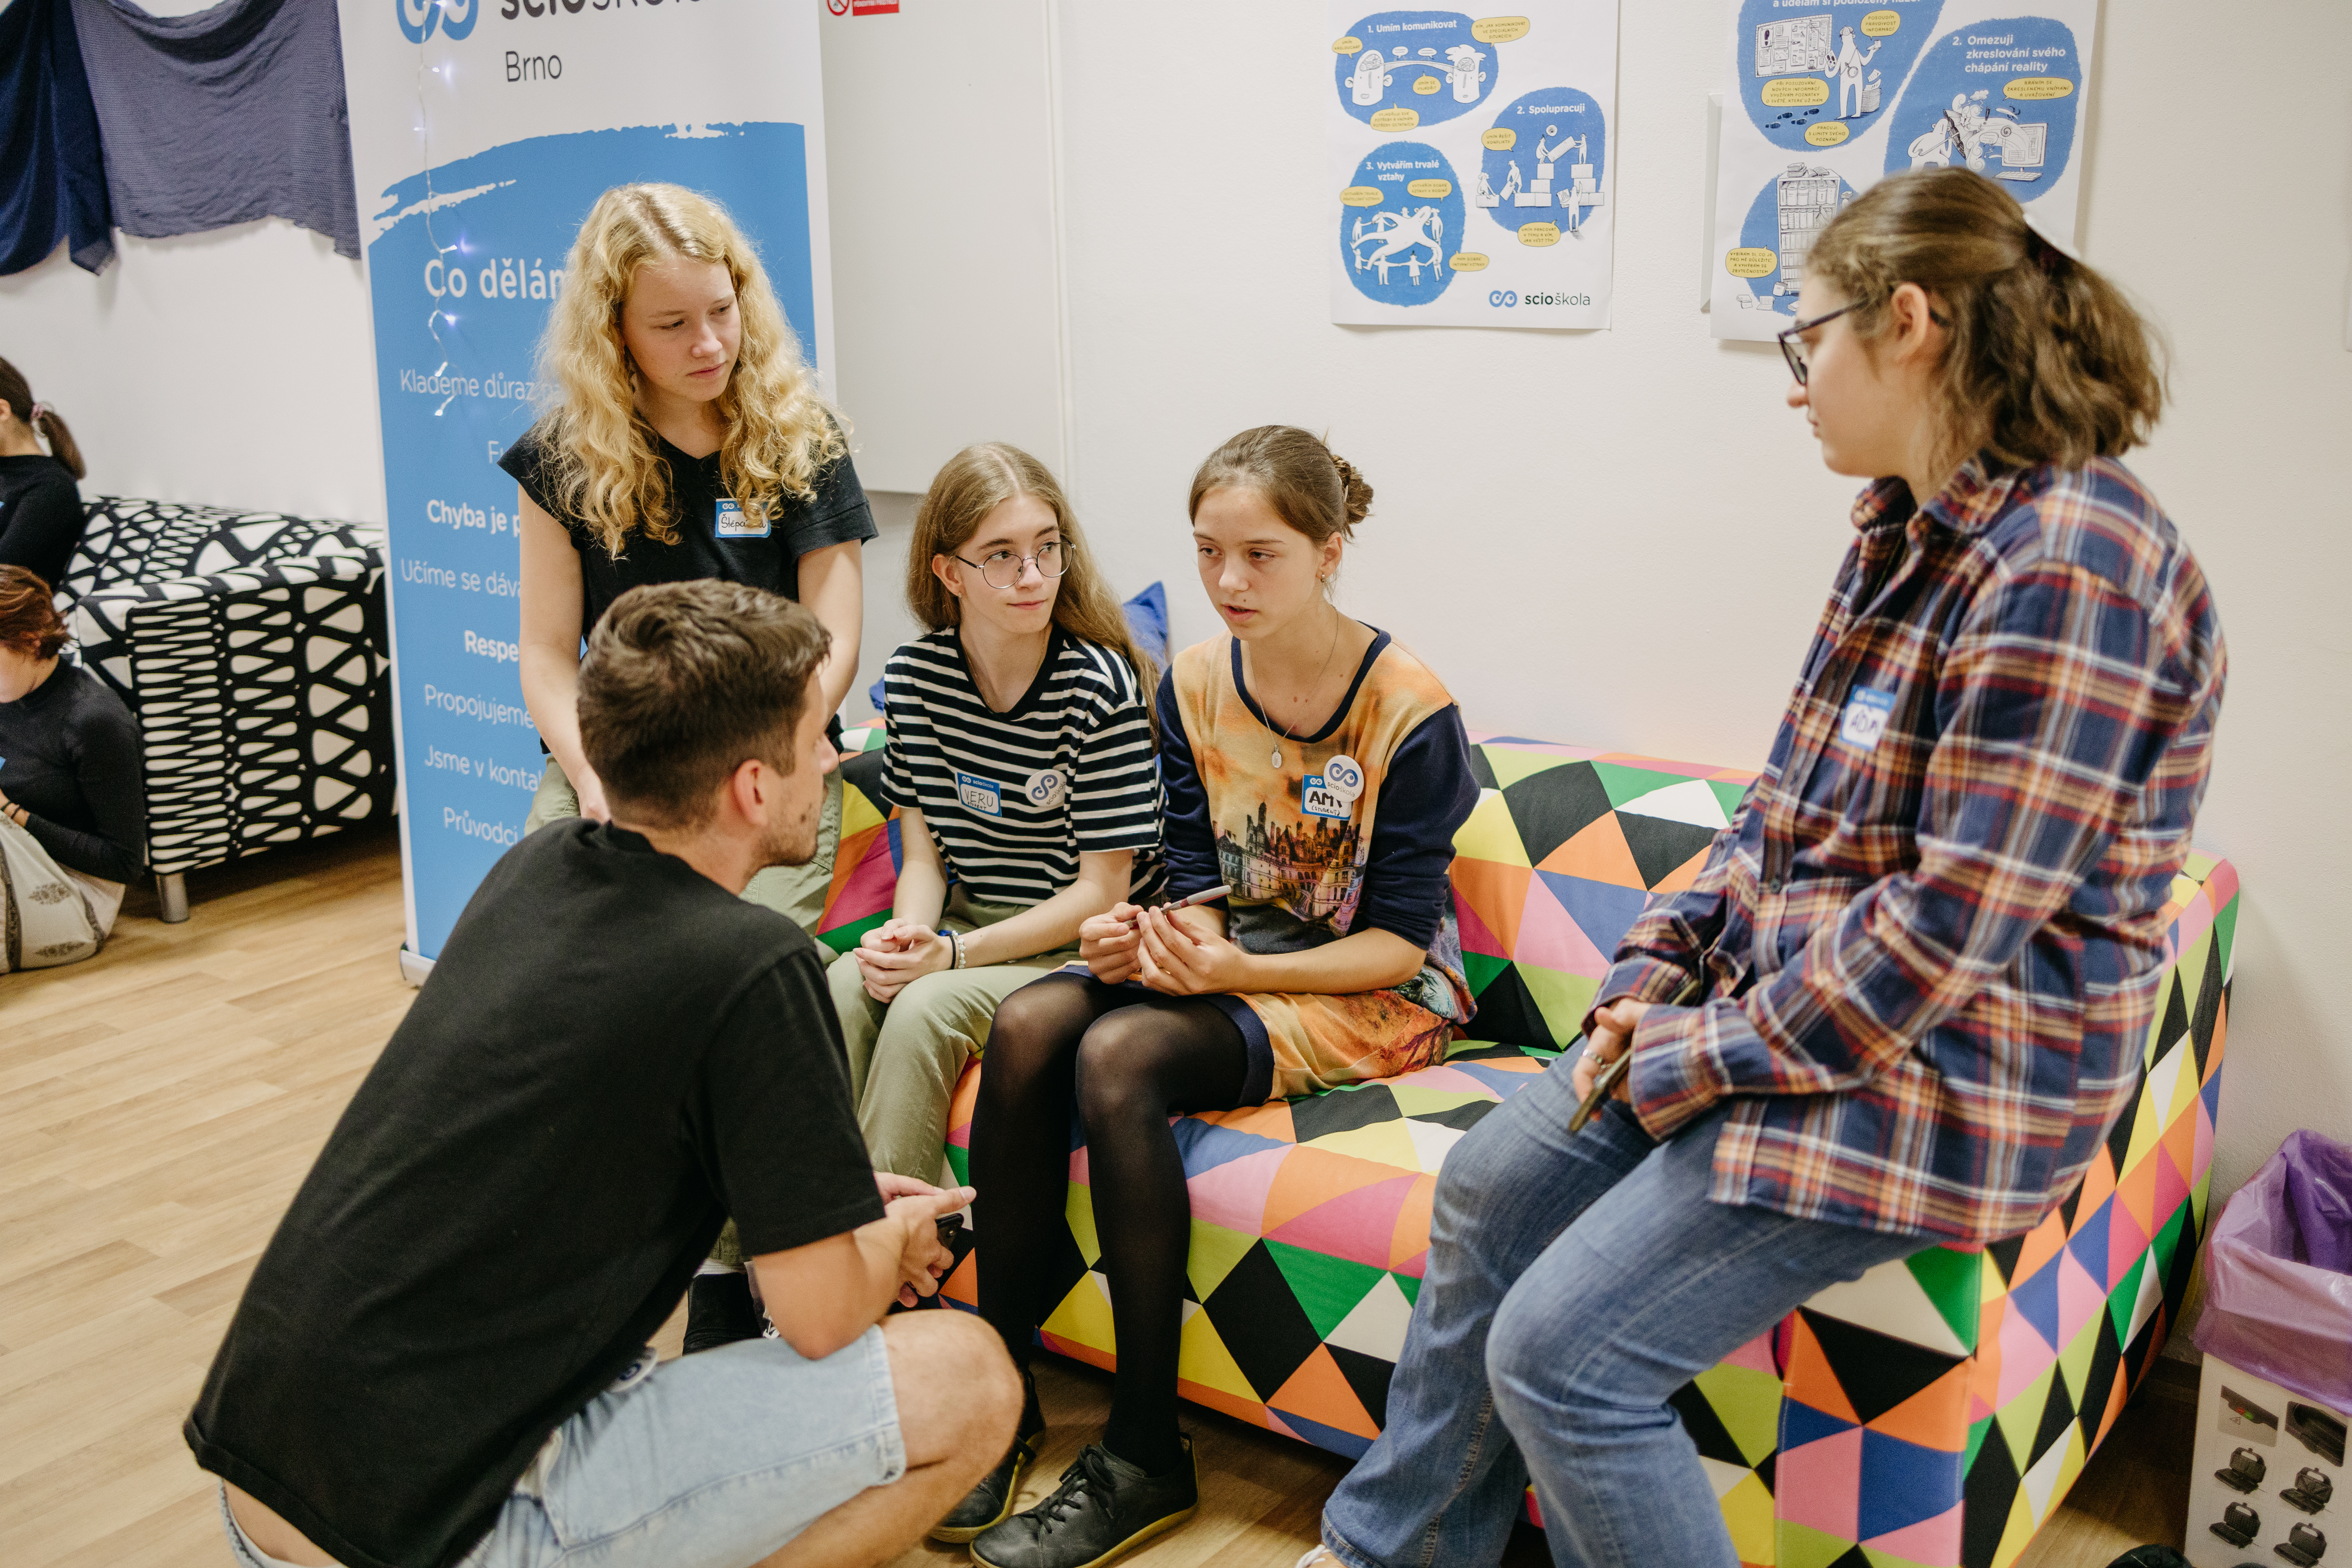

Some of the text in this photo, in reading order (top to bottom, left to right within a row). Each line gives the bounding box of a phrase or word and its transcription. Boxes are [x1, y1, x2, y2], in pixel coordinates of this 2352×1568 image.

[1376, 23, 1400, 32] Umím
[1403, 20, 1457, 31] komunikovat
[1952, 34, 2013, 46] 2. Omezuji
[1966, 47, 2066, 59] zkreslování svého
[506, 51, 561, 82] Brno
[1965, 61, 2048, 73] chápání reality
[1517, 103, 1585, 115] 2. Spolupracuji
[1366, 159, 1439, 171] 3. Vytvářím trvalé
[1378, 173, 1405, 182] vztahy
[424, 258, 467, 298] Co
[1525, 292, 1590, 305] scioškola
[400, 368, 479, 397] Klademe
[484, 372, 536, 401] důraz
[427, 499, 486, 530] Chyba
[491, 505, 507, 535] je
[401, 558, 520, 599] Učíme se dáv
[465, 630, 519, 664] Respe
[425, 684, 535, 729] Propojujeme
[425, 744, 542, 792] Jsme v konta
[973, 780, 994, 789] scioškola
[1327, 782, 1355, 797] scioškola
[965, 789, 993, 807] VERU
[1046, 781, 1066, 805] scioškola
[968, 801, 987, 811] STUDENT
[1311, 805, 1340, 816] (STUDENT)
[444, 807, 517, 846] Průvodci
